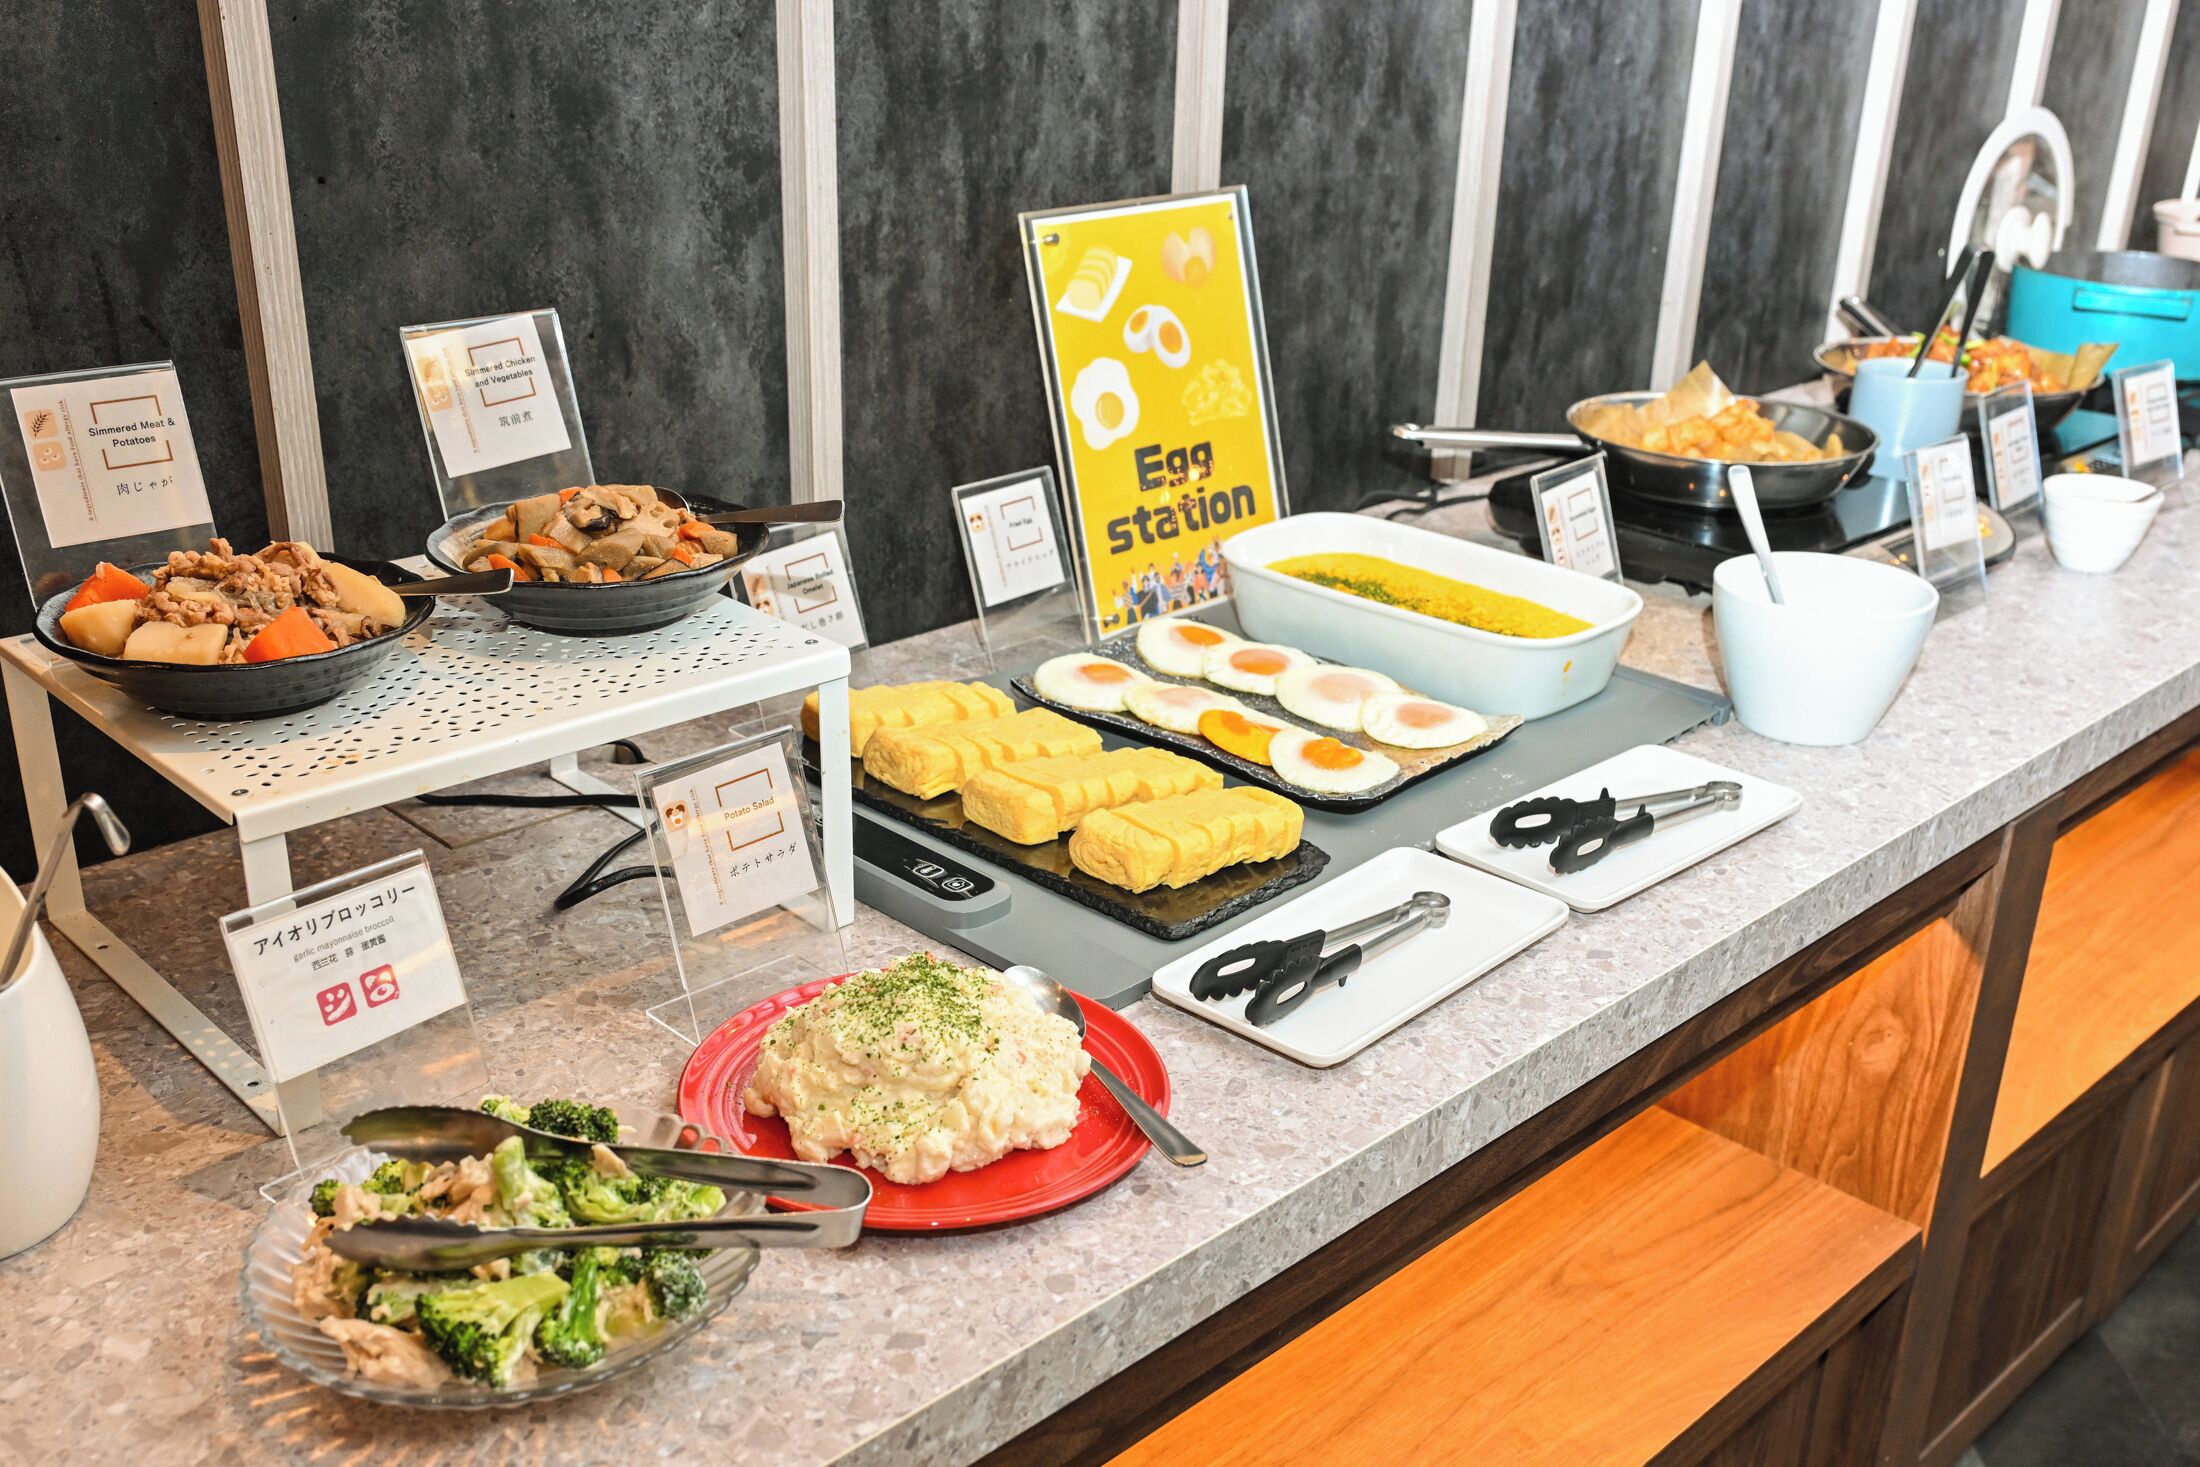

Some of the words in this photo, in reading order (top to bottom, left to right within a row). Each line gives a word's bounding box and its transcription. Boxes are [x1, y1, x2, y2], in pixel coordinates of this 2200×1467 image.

[465, 363, 503, 377] Simmered
[505, 355, 536, 368] Chicken
[475, 378, 489, 388] and
[491, 369, 533, 384] Vegetables
[88, 422, 137, 437] Simmered
[140, 419, 165, 430] Meat
[167, 417, 176, 427] &
[112, 435, 156, 448] Potatoes
[76, 469, 84, 481] that
[1134, 441, 1214, 492] Egg
[116, 476, 174, 496] 肉じゃが
[1107, 485, 1256, 555] station
[787, 576, 814, 589] Japanese
[802, 583, 824, 595] Omelet
[724, 806, 751, 821] Potato
[752, 796, 775, 811] Salad
[730, 842, 798, 878] ポテトサラダ
[253, 884, 415, 955] アイオリブロッコリー
[293, 946, 316, 963] garlic
[316, 929, 364, 953] mayonnaise
[364, 915, 395, 933] broccoli
[312, 953, 338, 971] 西兰花
[361, 934, 386, 951] 蛋黄酱
